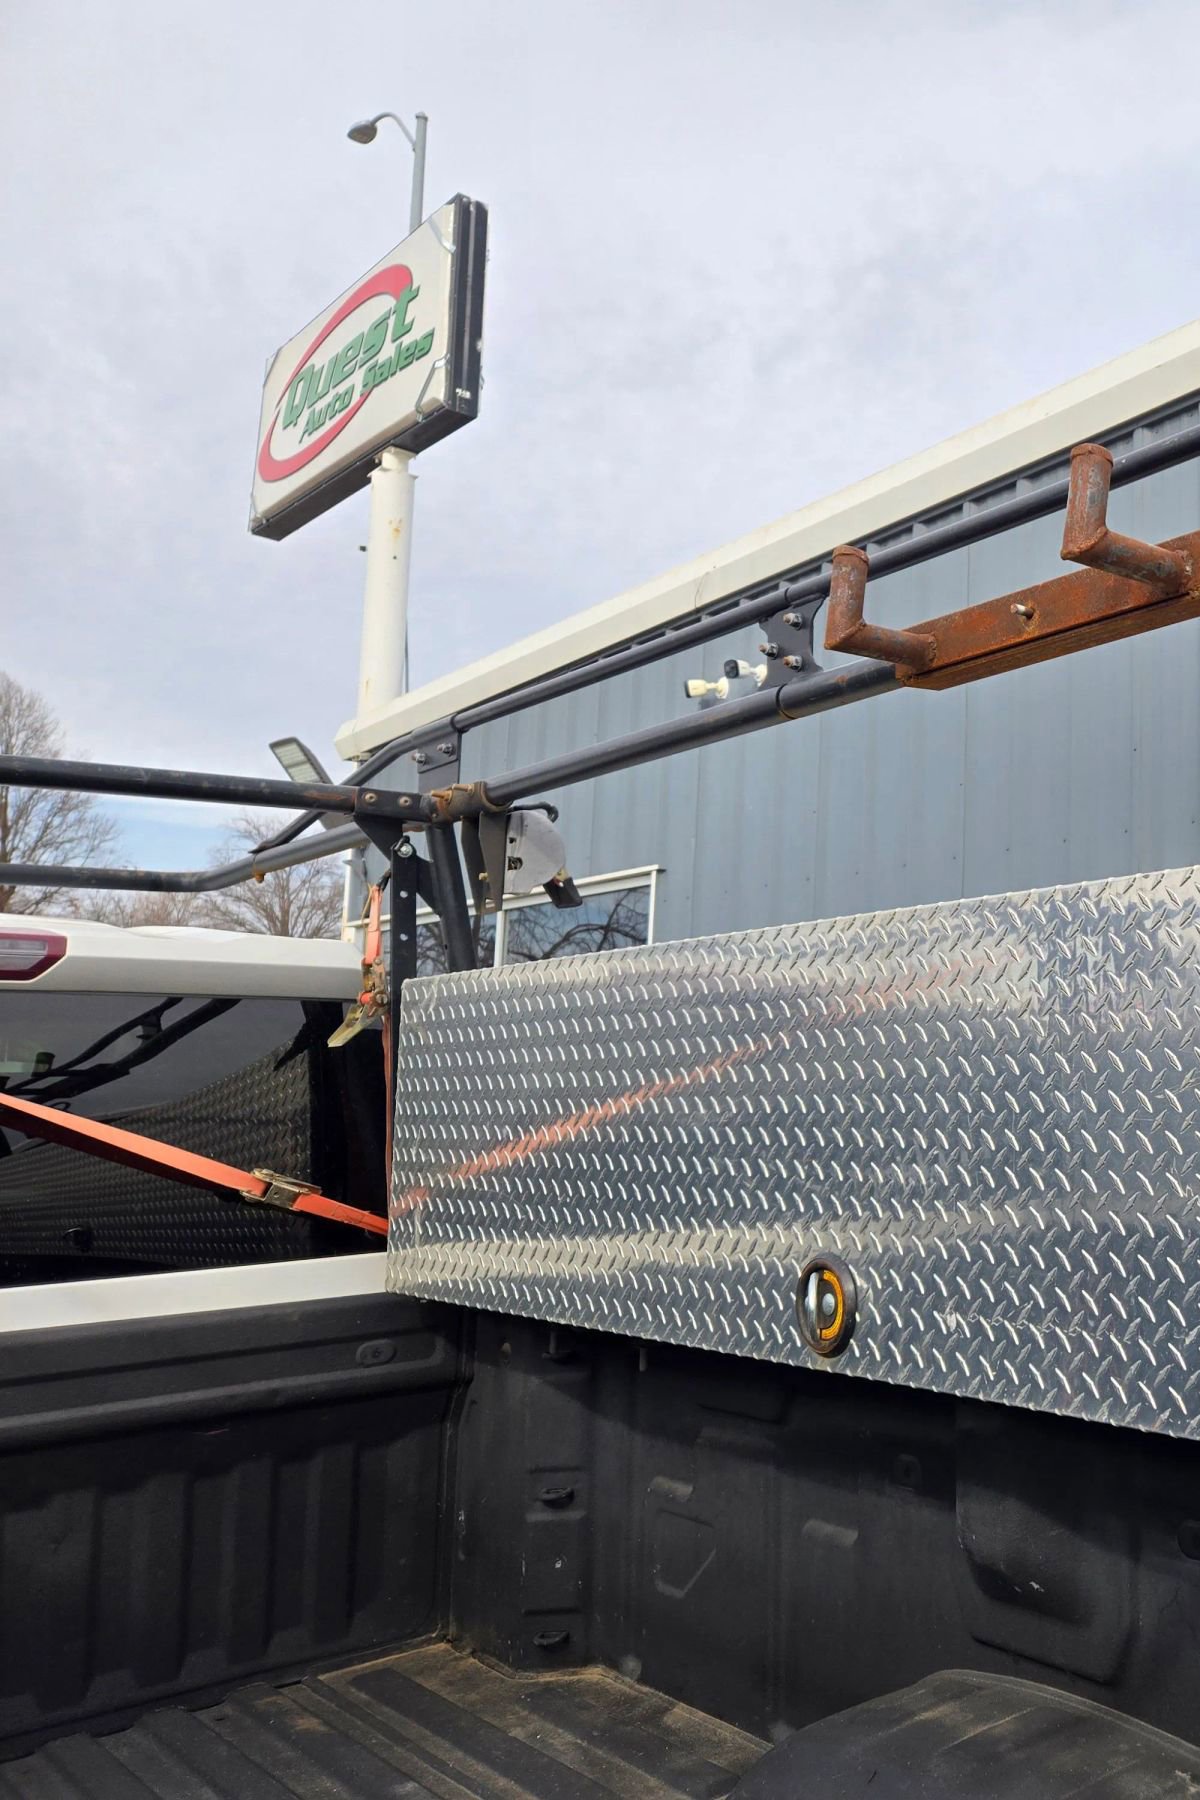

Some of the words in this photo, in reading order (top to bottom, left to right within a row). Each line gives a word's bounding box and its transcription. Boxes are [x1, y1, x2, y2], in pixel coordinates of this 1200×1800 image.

[282, 284, 421, 431] Quest
[298, 383, 356, 444] Auto
[359, 327, 436, 397] Sales
